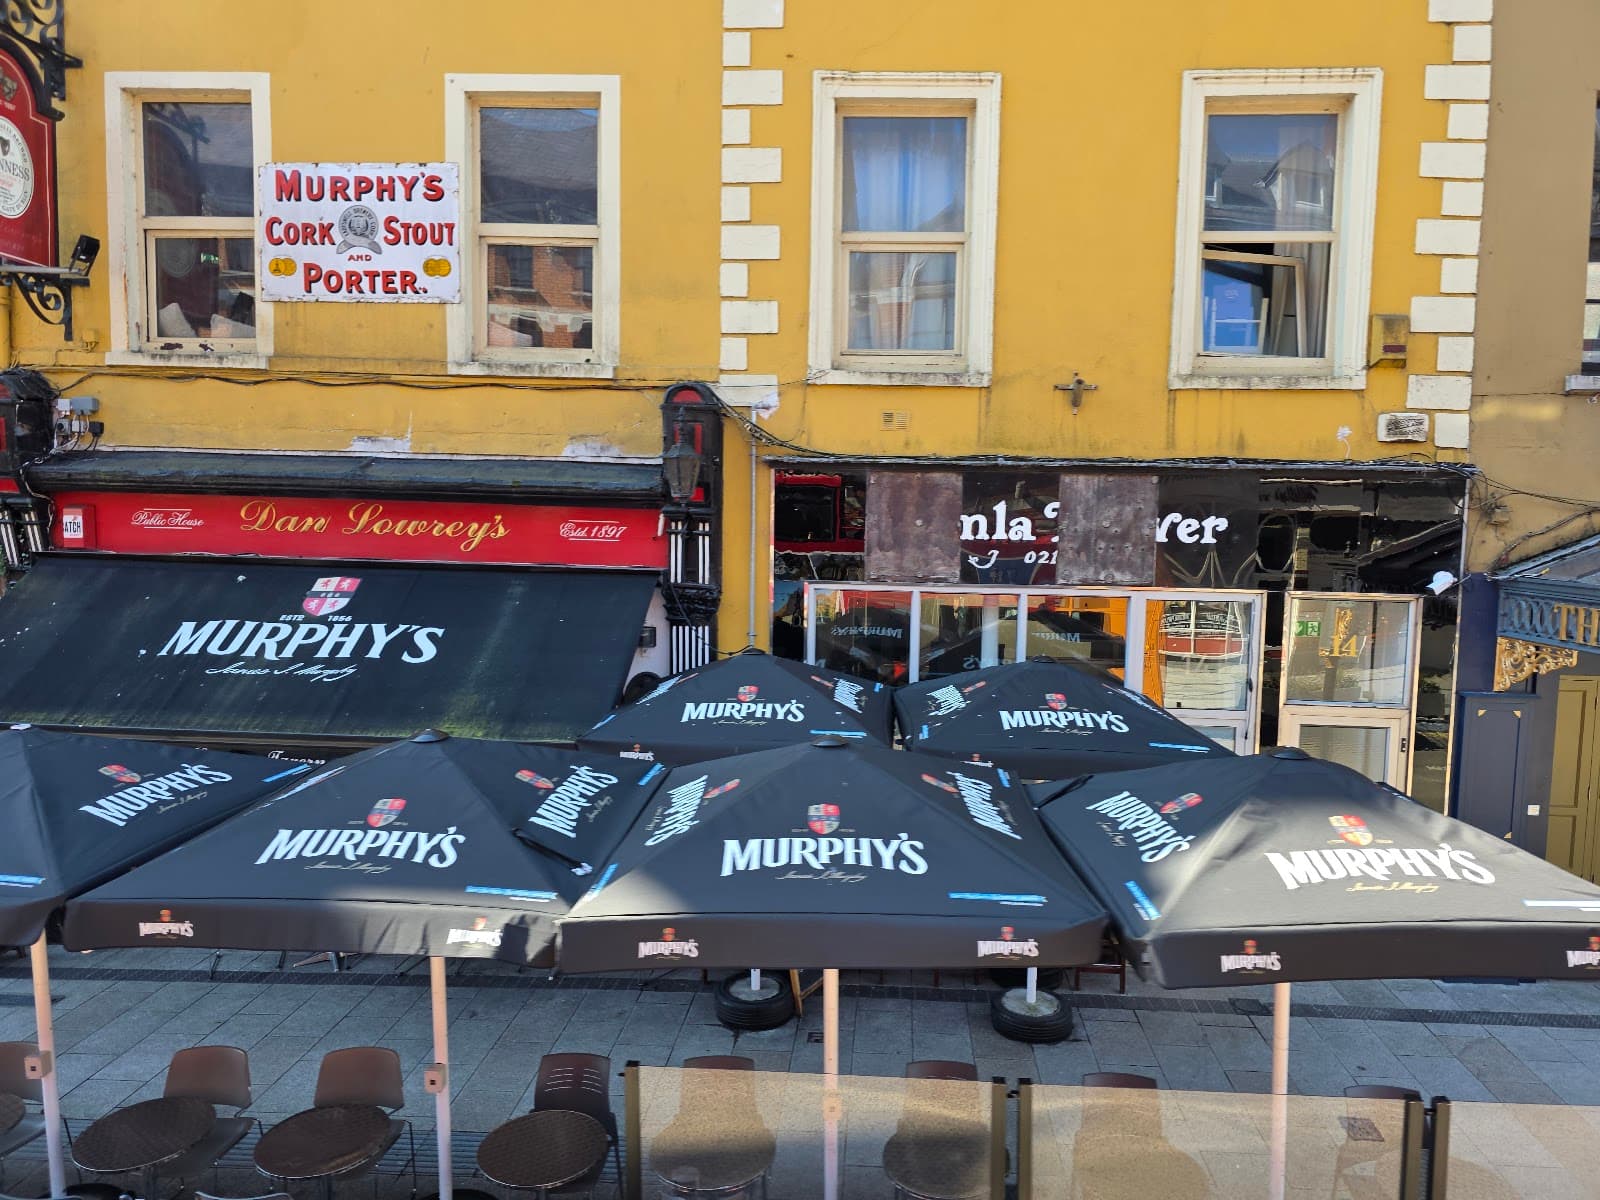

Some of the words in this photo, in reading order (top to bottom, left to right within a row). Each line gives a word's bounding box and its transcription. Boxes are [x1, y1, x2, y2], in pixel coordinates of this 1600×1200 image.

[275, 169, 445, 202] MURPHY'S
[265, 216, 336, 246] CORK
[383, 215, 456, 246] STOUT
[347, 254, 372, 262] AND
[131, 510, 166, 526] Public
[167, 511, 204, 527] House
[240, 500, 331, 533] Dan
[341, 502, 511, 552] Lowrey's
[590, 526, 627, 538] 1897
[157, 619, 445, 664] MURPHY'S
[680, 700, 805, 723] MURPHY'S
[999, 710, 1130, 733] MURPHY'S
[77, 763, 233, 827] MURPHY'S
[528, 765, 618, 838] MURPHY'S
[254, 826, 466, 868] MURPHY'S
[1085, 791, 1197, 863] MURPHY'S
[720, 833, 928, 876] MURPHY'S
[1264, 843, 1496, 890] MURPHY'S
